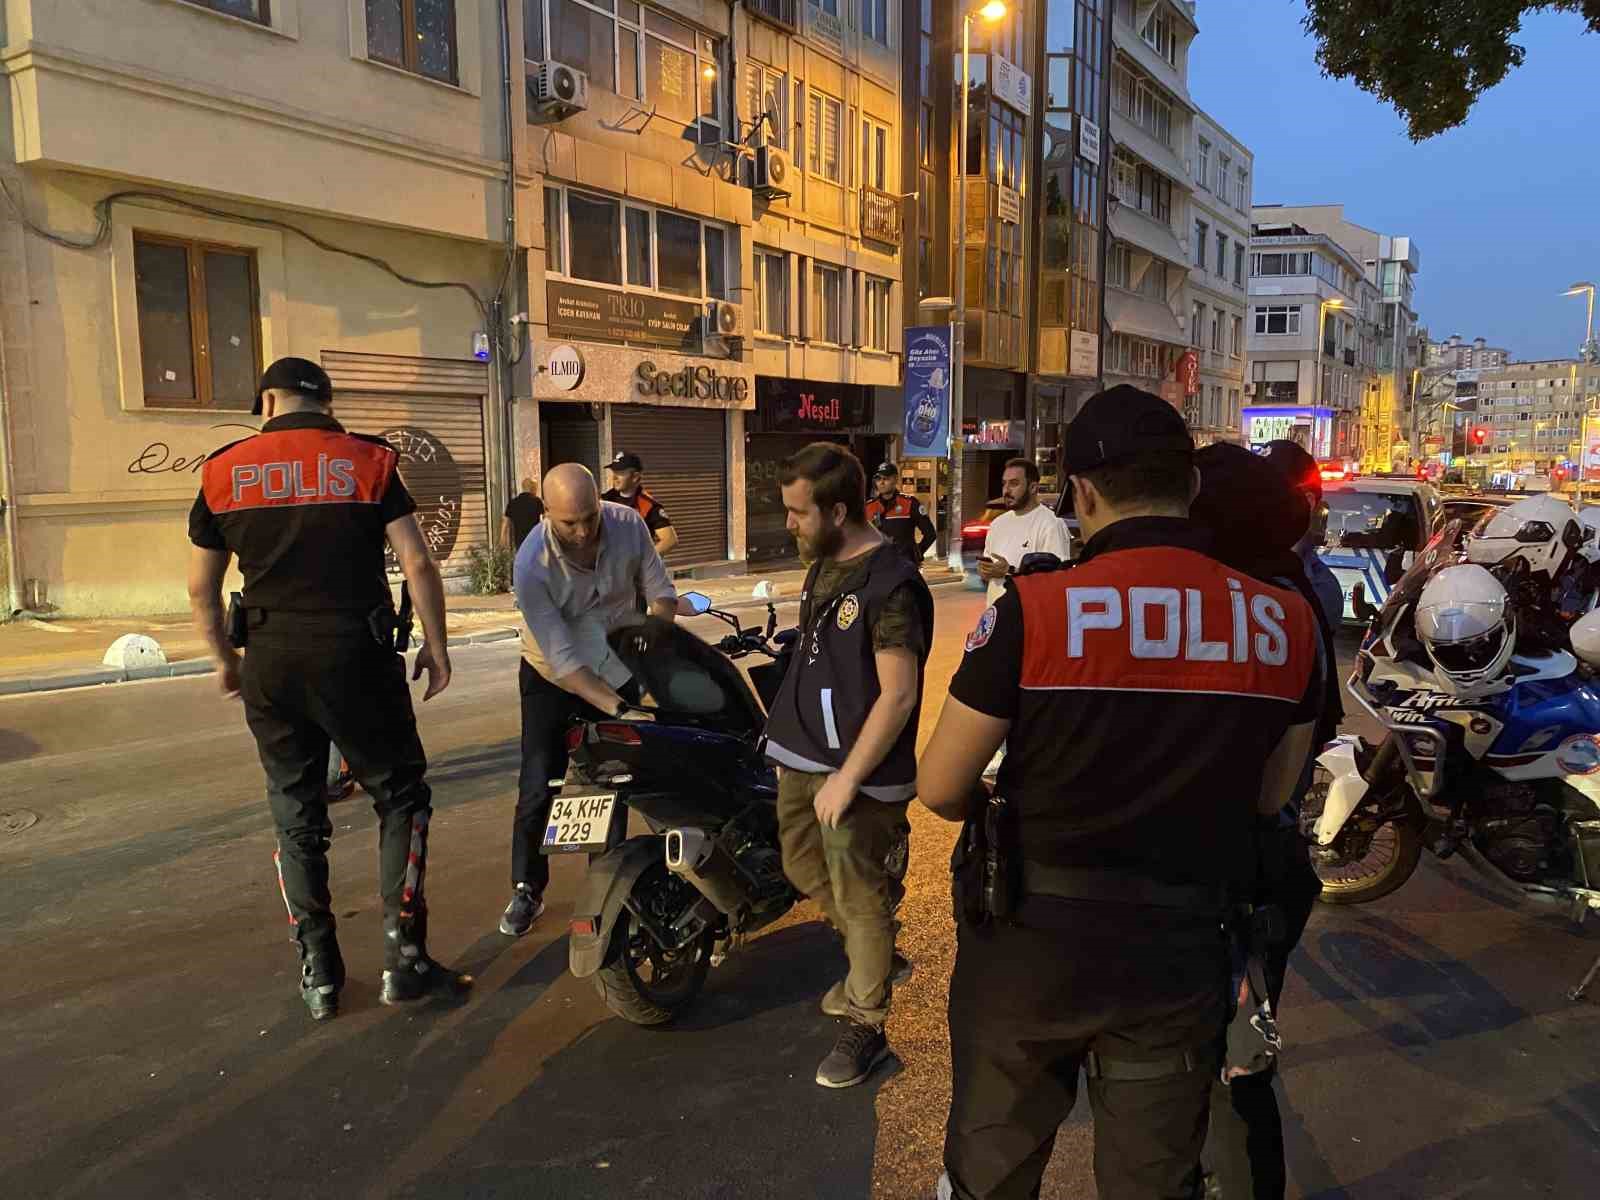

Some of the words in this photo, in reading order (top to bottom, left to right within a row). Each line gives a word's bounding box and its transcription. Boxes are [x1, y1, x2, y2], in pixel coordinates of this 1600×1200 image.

[608, 295, 645, 318] TRIO
[232, 452, 356, 502] POLİS
[1065, 578, 1289, 666] POLİS
[552, 800, 573, 820] 34
[576, 797, 612, 819] KHF
[558, 822, 591, 842] 229
